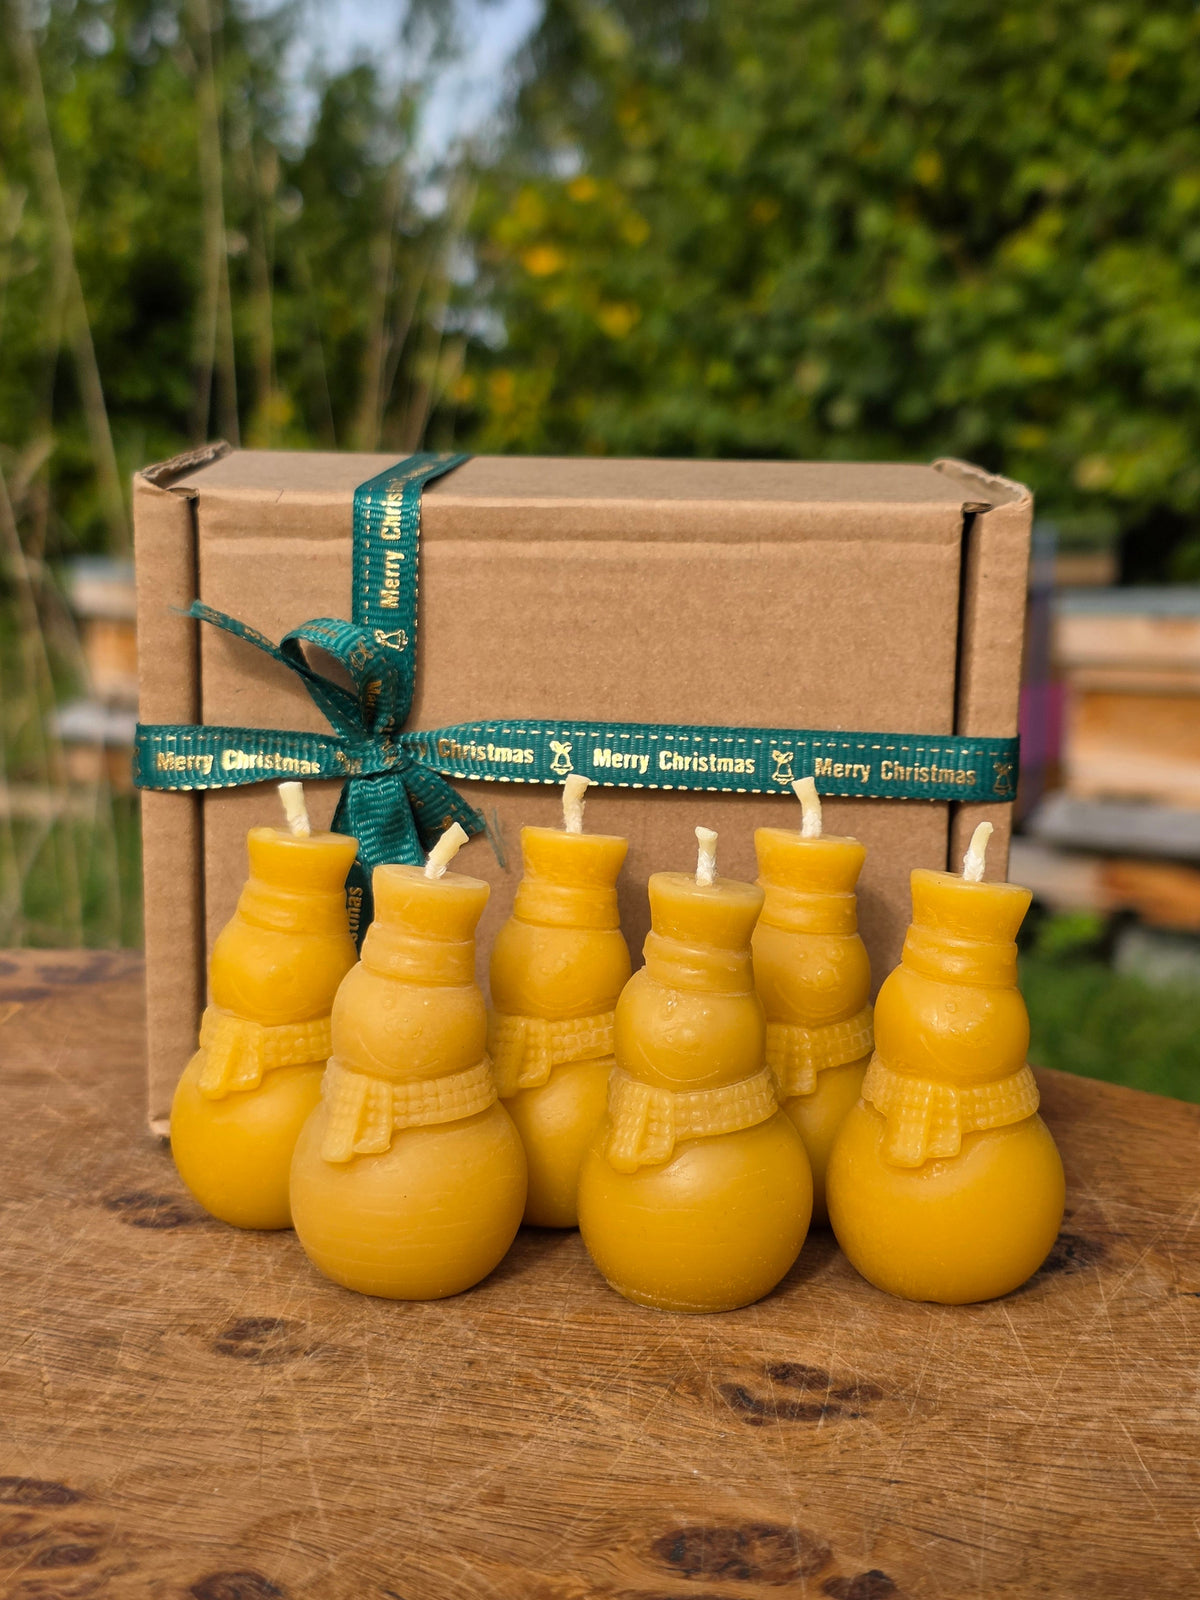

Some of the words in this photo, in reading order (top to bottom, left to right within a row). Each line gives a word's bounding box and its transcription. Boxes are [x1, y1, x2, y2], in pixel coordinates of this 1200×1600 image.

[379, 550, 405, 609] Merry
[156, 750, 214, 775] Merry
[221, 749, 321, 775] Christmas
[438, 738, 535, 765] Christmas
[593, 748, 650, 774] Merry
[658, 749, 756, 774] Christmas
[814, 757, 871, 783] Merry
[880, 760, 977, 786] Christmas
